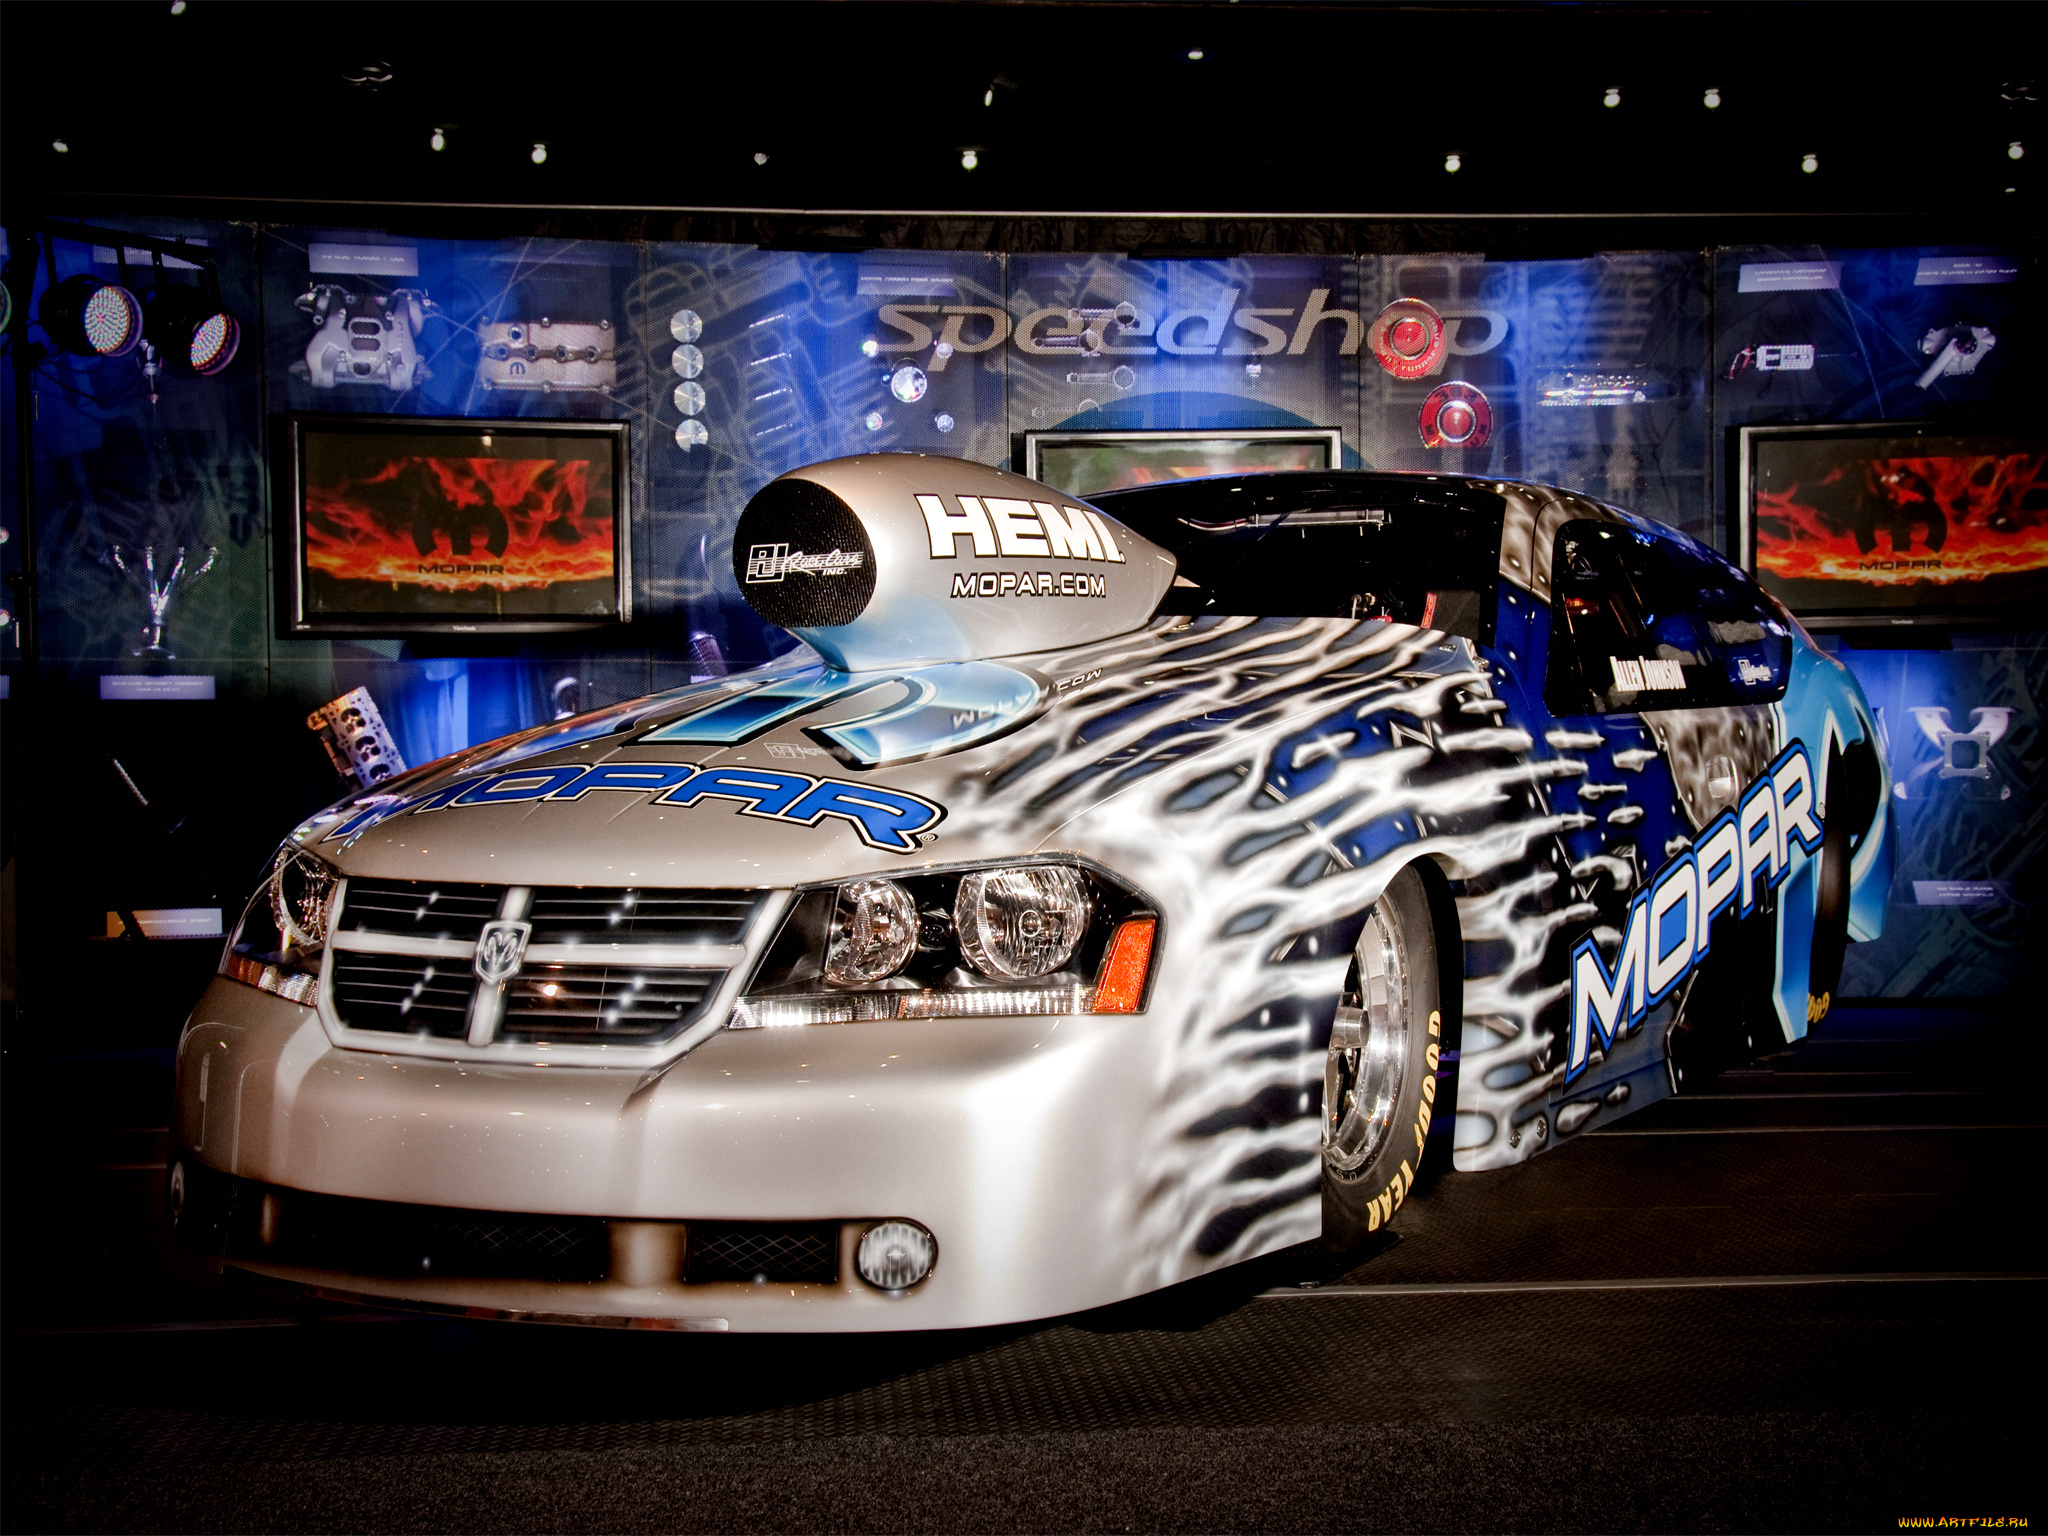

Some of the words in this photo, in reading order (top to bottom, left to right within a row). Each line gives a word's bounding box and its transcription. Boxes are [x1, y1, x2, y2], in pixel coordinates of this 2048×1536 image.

[418, 564, 504, 575] MOPAR
[1860, 559, 1942, 571] MOPAR
[950, 571, 1107, 598] MOPAR.COM
[320, 761, 948, 857] MOPAR
[1562, 737, 1824, 1096] MOPAR
